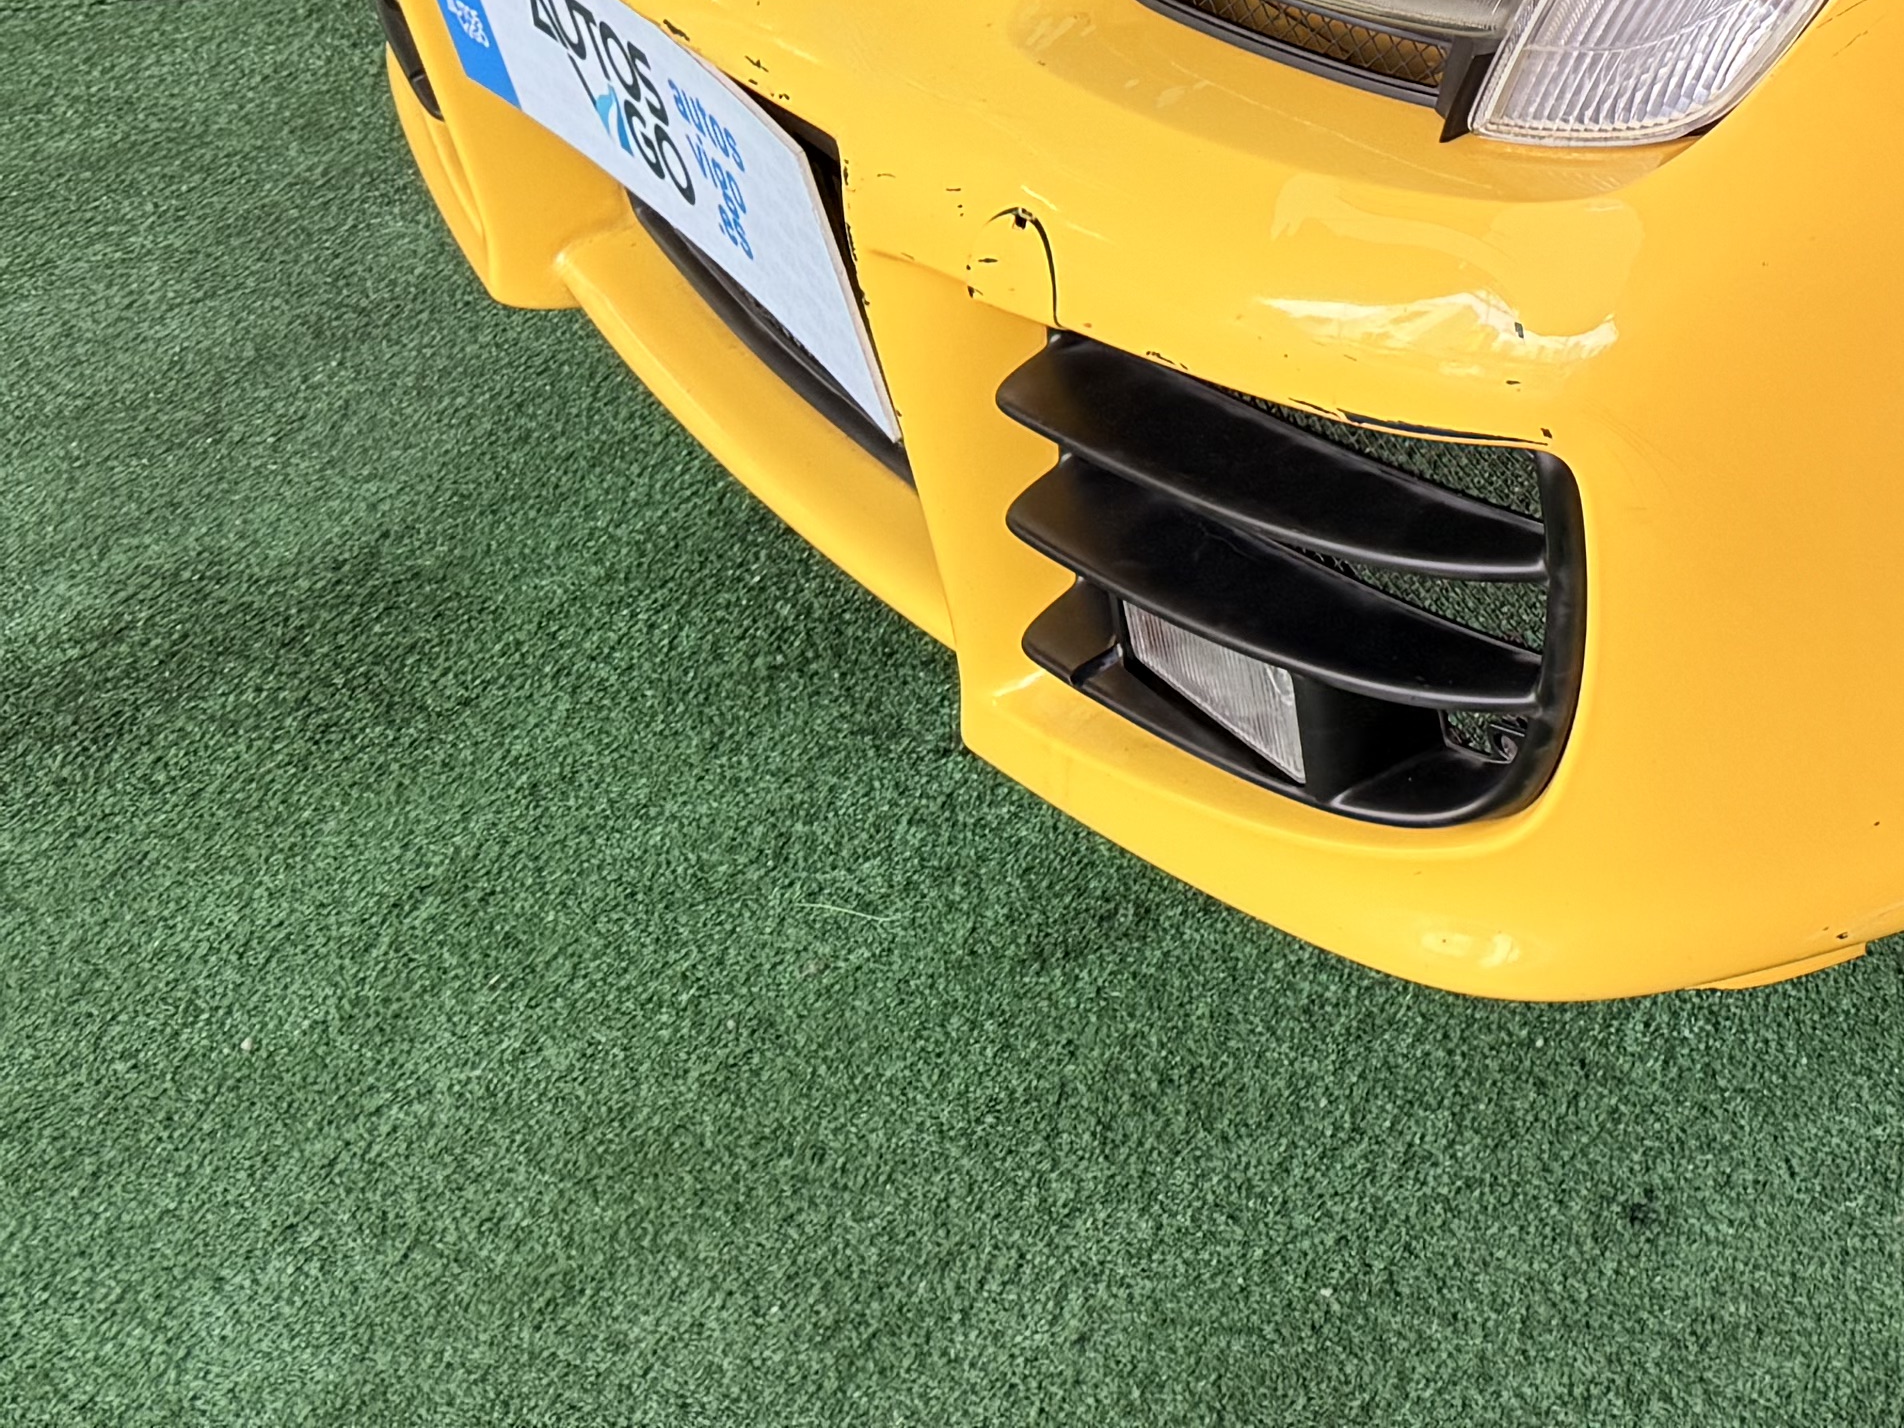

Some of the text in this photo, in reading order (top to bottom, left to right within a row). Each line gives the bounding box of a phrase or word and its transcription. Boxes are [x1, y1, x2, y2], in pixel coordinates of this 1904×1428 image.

[566, 52, 696, 206] VIGO
[667, 78, 745, 173] autos
[686, 133, 747, 219] vigo
